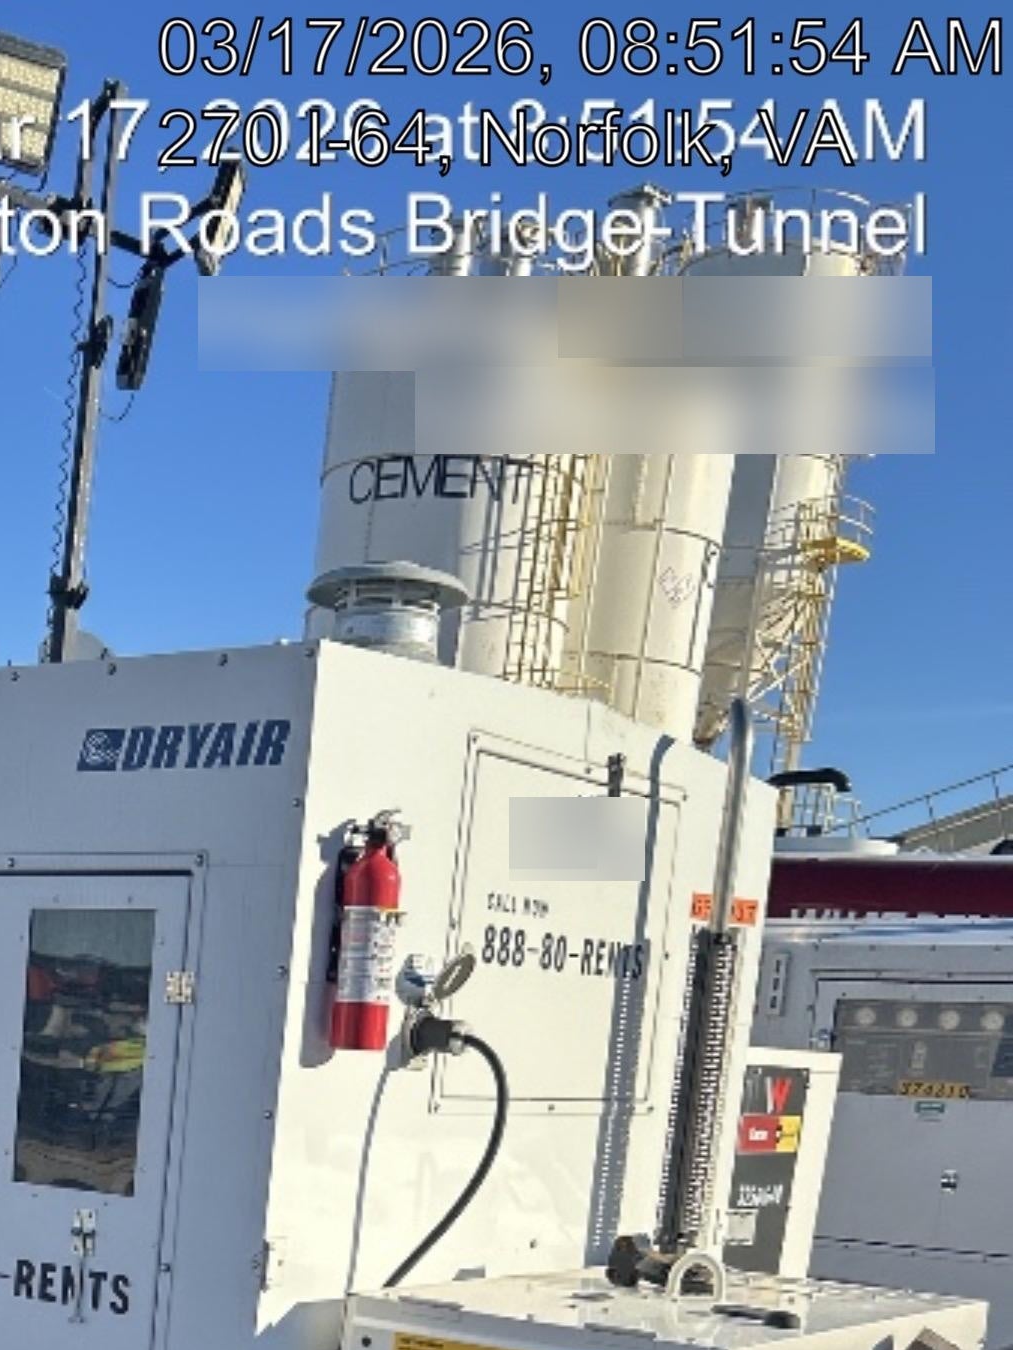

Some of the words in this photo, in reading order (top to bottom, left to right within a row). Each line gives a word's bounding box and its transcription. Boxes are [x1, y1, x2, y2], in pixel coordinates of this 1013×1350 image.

[348, 454, 533, 504] CEMENT
[121, 718, 291, 772] DRYAIR
[482, 924, 645, 979] 888-80-RENTS
